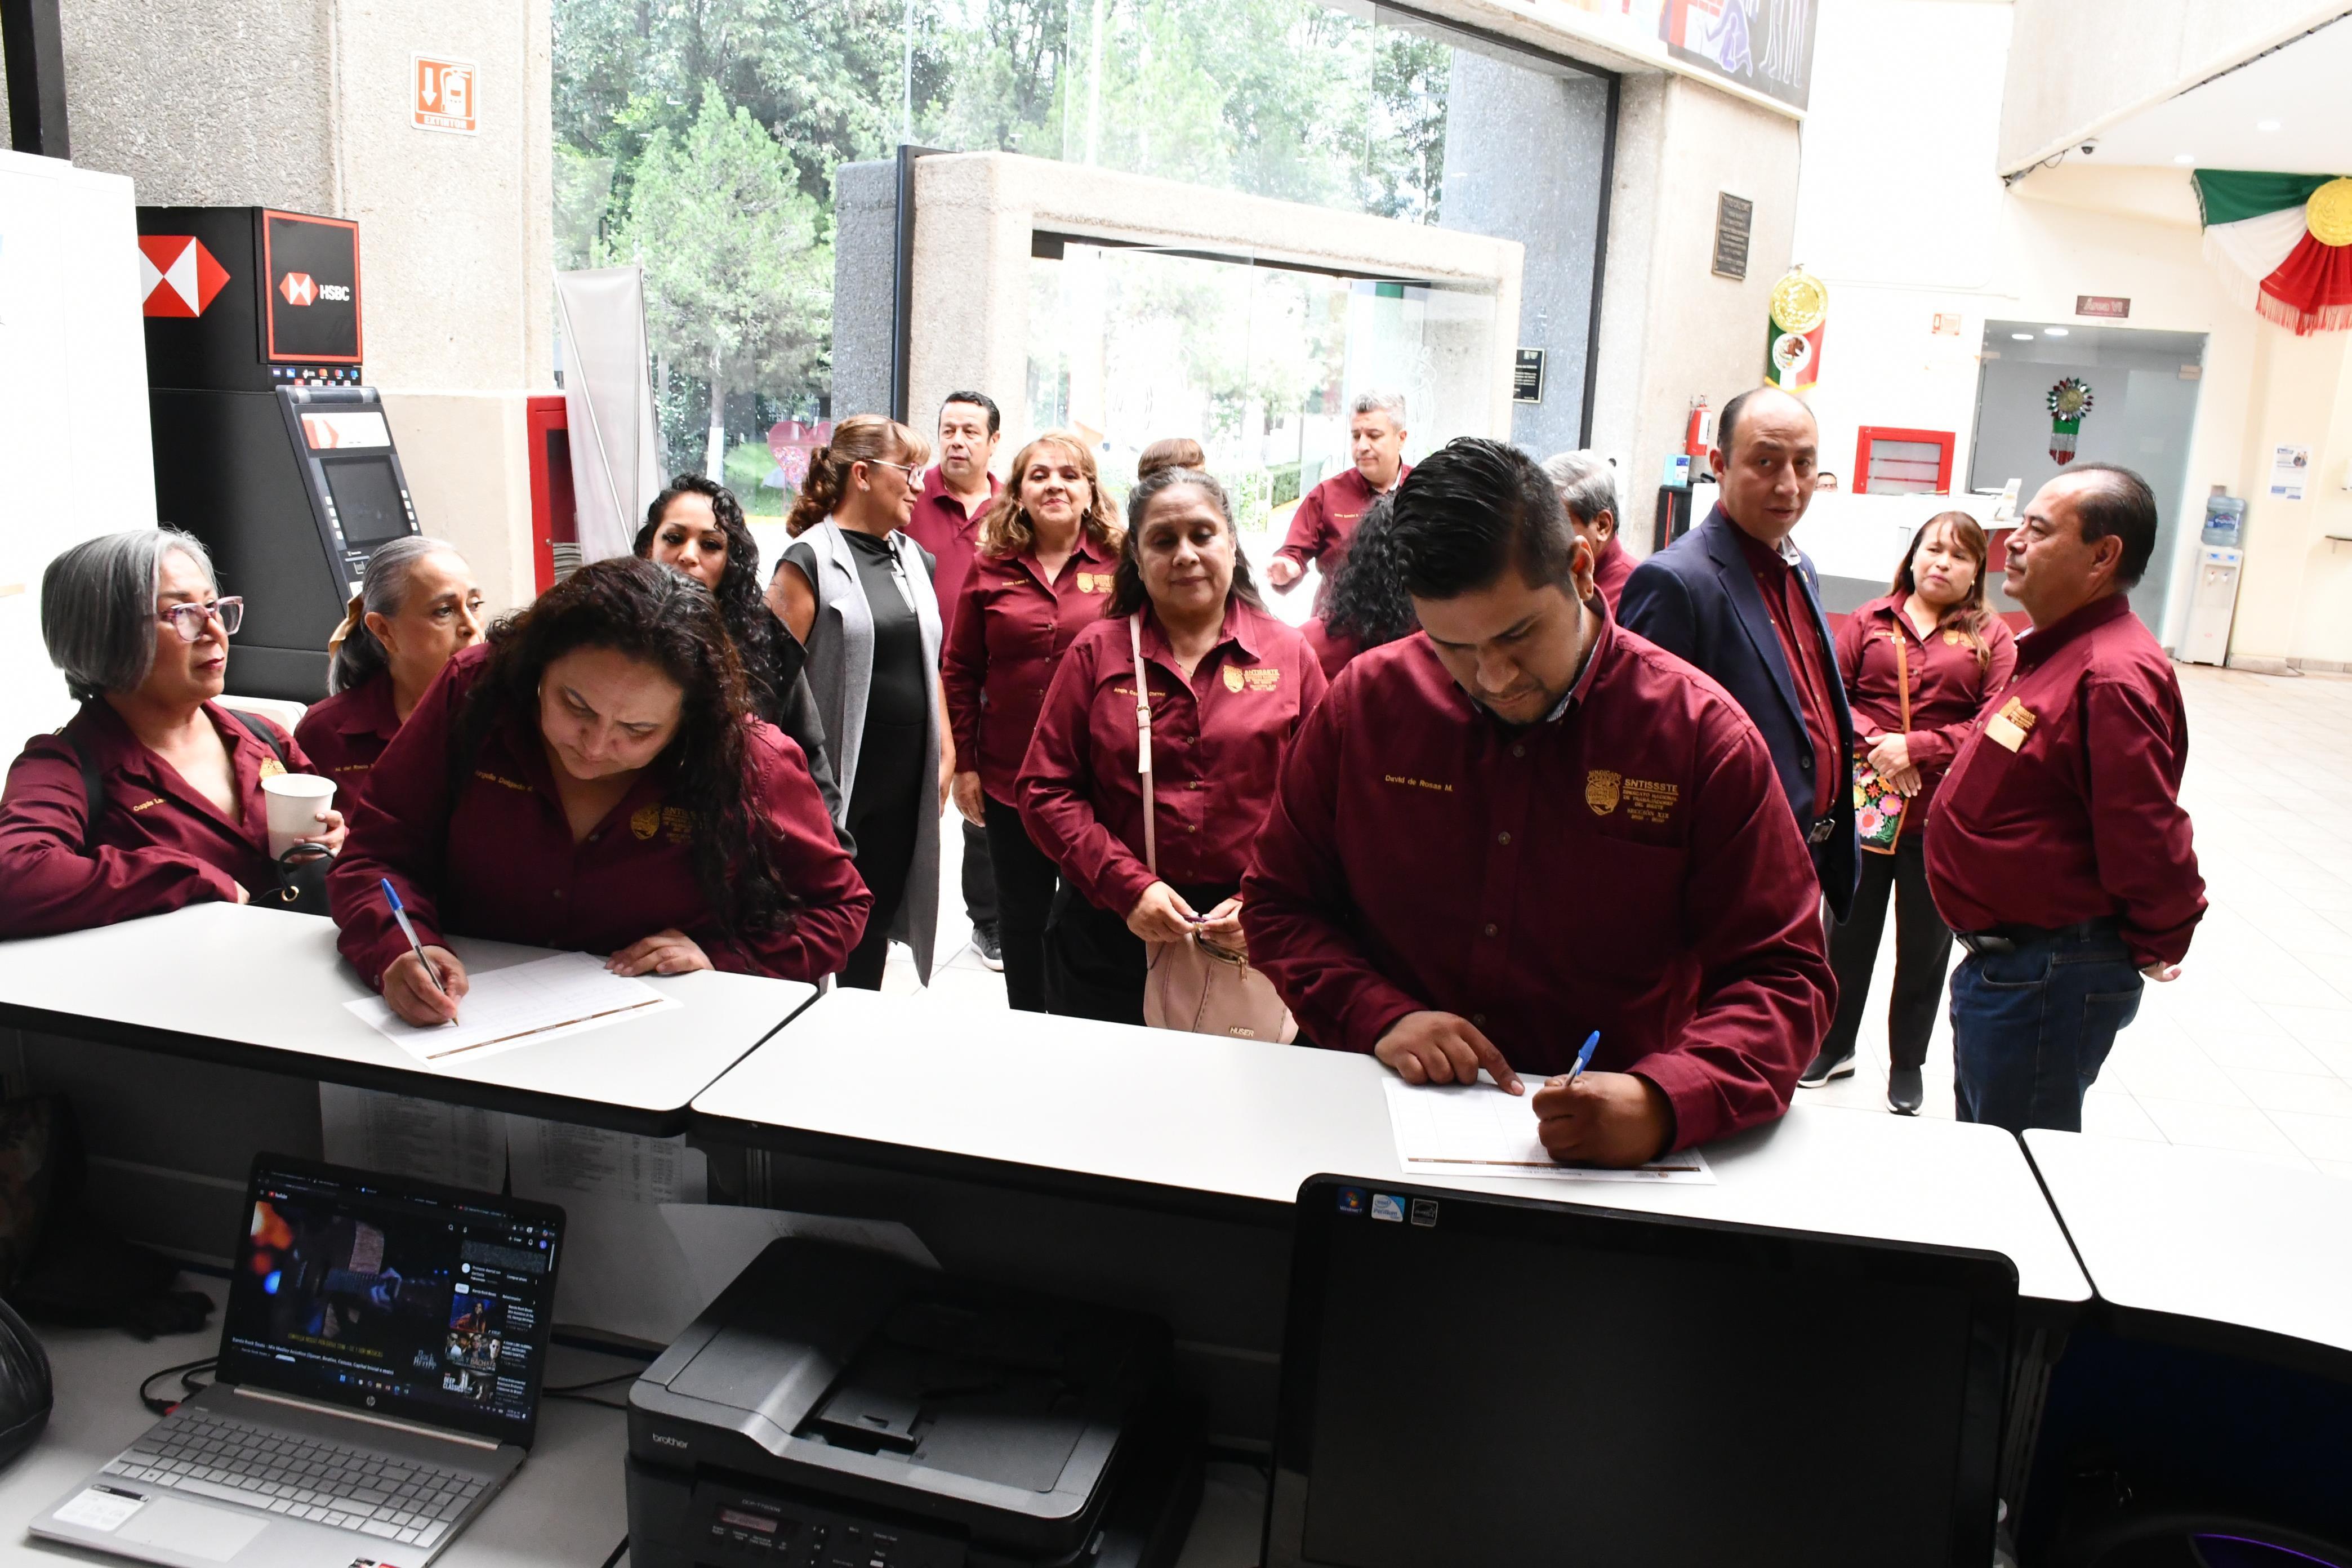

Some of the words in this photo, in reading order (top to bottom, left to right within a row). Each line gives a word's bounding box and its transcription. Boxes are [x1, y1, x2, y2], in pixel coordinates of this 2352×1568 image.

[424, 114, 467, 130] EXTINTOR
[319, 284, 350, 301] HSBC
[1386, 774, 1405, 783] David
[1419, 779, 1441, 790] Rosas
[1625, 778, 1678, 793] SNTISSSTE
[653, 1433, 688, 1449] brother
